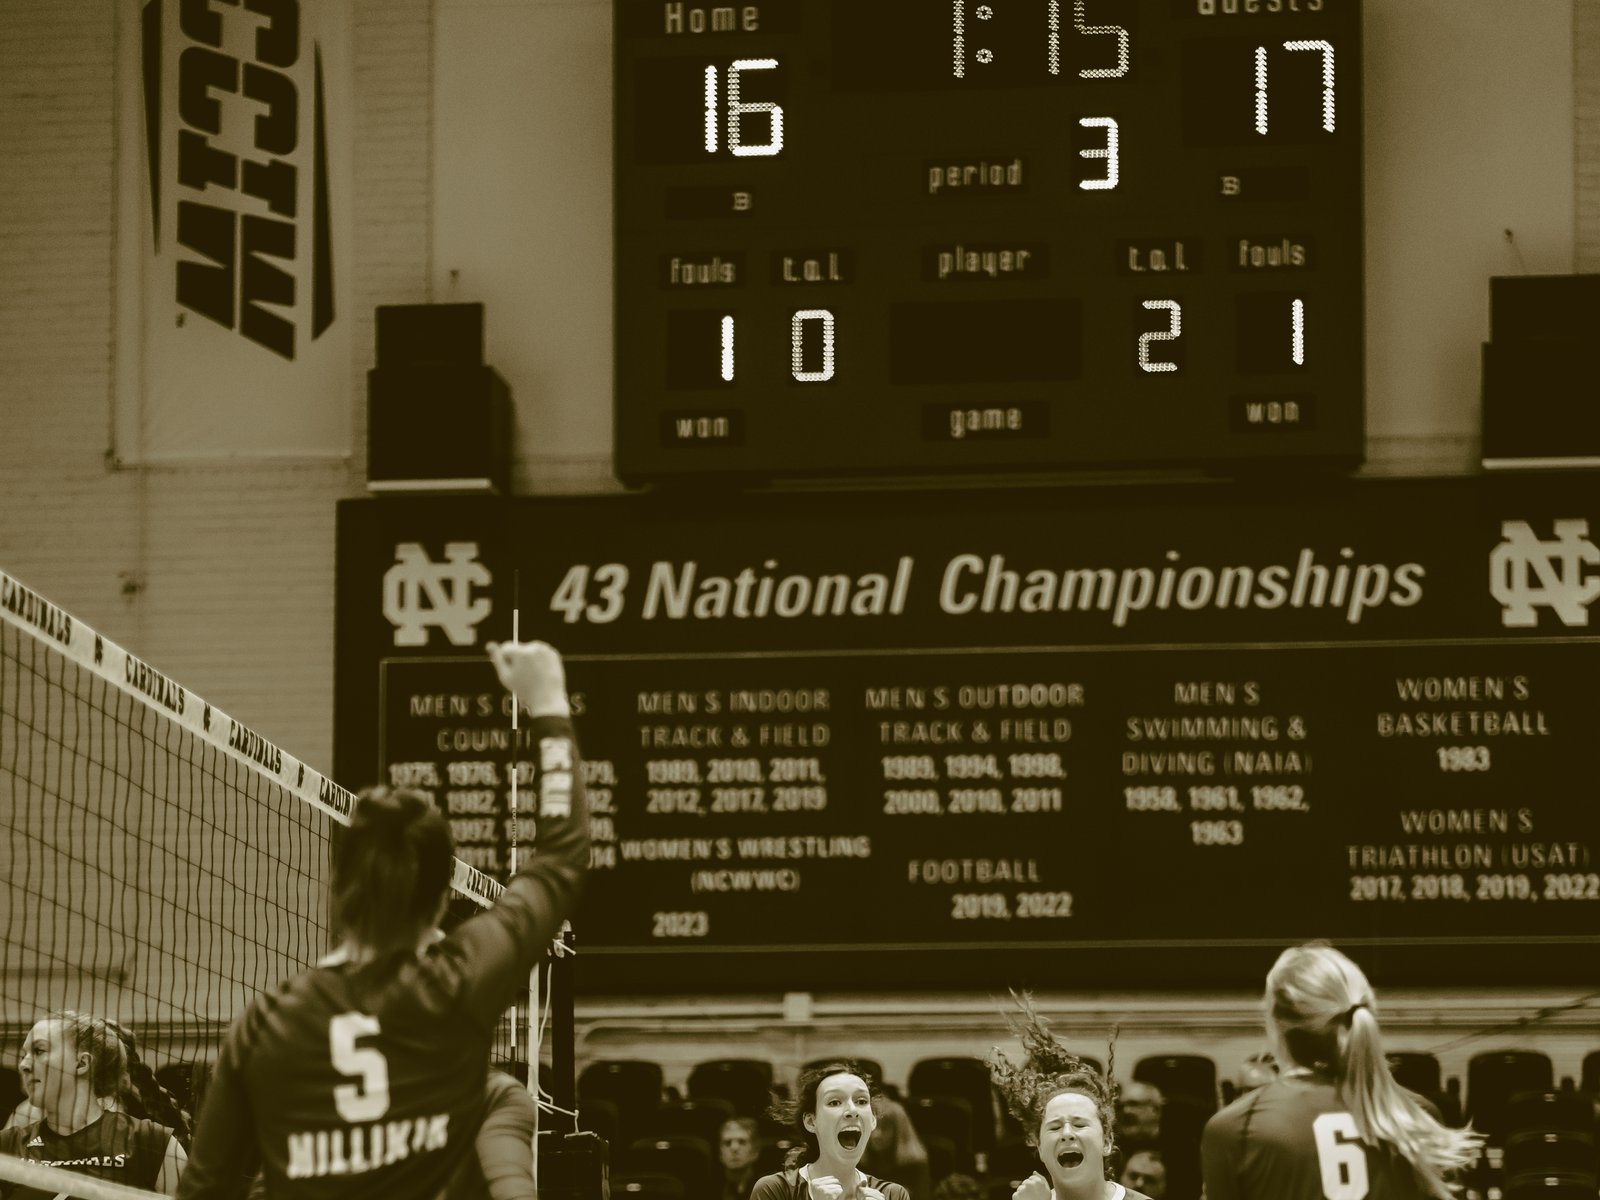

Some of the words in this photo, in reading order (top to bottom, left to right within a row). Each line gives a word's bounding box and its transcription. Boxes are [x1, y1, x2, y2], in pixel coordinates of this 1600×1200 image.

[664, 2, 760, 34] Home
[1255, 40, 1336, 135] 17
[704, 58, 784, 157] 16
[1079, 117, 1119, 190] 3
[929, 159, 1022, 194] period
[939, 245, 1031, 279] player
[1239, 238, 1306, 267] fouls
[671, 256, 736, 284] fouls
[792, 310, 835, 381] 0
[1139, 300, 1181, 372] 2
[1292, 298, 1304, 365] 1
[721, 315, 734, 382] 1
[950, 408, 1022, 438] game
[1246, 401, 1300, 424] won
[676, 417, 730, 438] won
[549, 563, 631, 624] 43
[640, 556, 915, 620] National
[939, 546, 1427, 627] Championships
[125, 652, 186, 716] CARDINALS
[958, 683, 1085, 709] OUTDOOR
[729, 688, 831, 713] INDOOR
[641, 725, 722, 749] TRACK
[730, 725, 751, 749] &
[759, 723, 832, 748] FIELD
[880, 720, 963, 744] TRACK
[971, 719, 992, 744] &
[1000, 717, 1073, 744] FIELD
[1125, 714, 1280, 742] SWIMMING
[1286, 713, 1308, 742] &
[1376, 709, 1551, 738] BASKETBALL
[228, 718, 282, 776] CARDINALS
[1436, 745, 1491, 772] 1983
[1121, 750, 1216, 776] DIVING
[1011, 786, 1063, 814] 2011
[1189, 818, 1245, 846] 1963
[620, 837, 733, 861] WOMEN'S
[737, 835, 872, 859] WRESTLING
[1346, 844, 1493, 871] TRIATHLON
[907, 857, 1042, 885] FOOTBALL
[1015, 890, 1074, 919] 2022
[652, 911, 709, 937] 2023
[328, 1010, 391, 1123] 5
[286, 1112, 450, 1180] MILLIKIN
